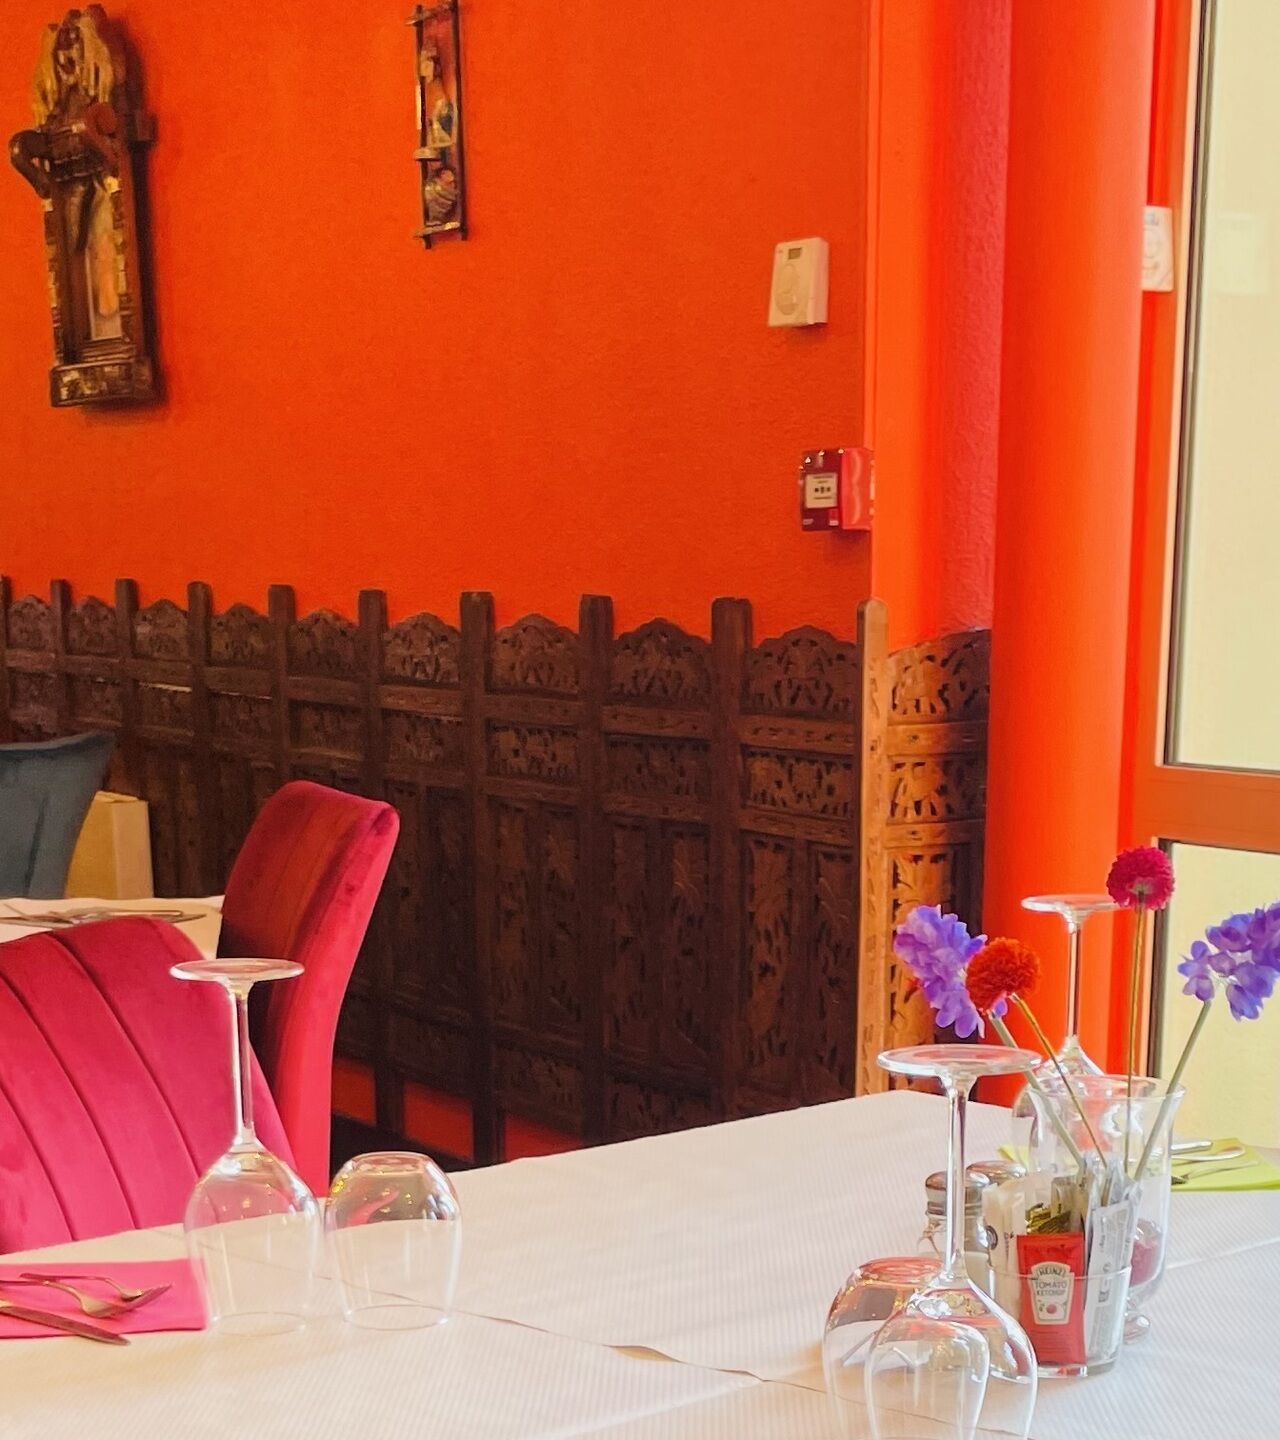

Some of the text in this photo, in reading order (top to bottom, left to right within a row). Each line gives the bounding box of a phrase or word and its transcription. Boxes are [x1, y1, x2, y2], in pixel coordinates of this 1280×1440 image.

[1036, 1266, 1067, 1278] HEINZ
[1035, 1281, 1067, 1290] TOMATO
[1036, 1289, 1066, 1297] KETCHUP
